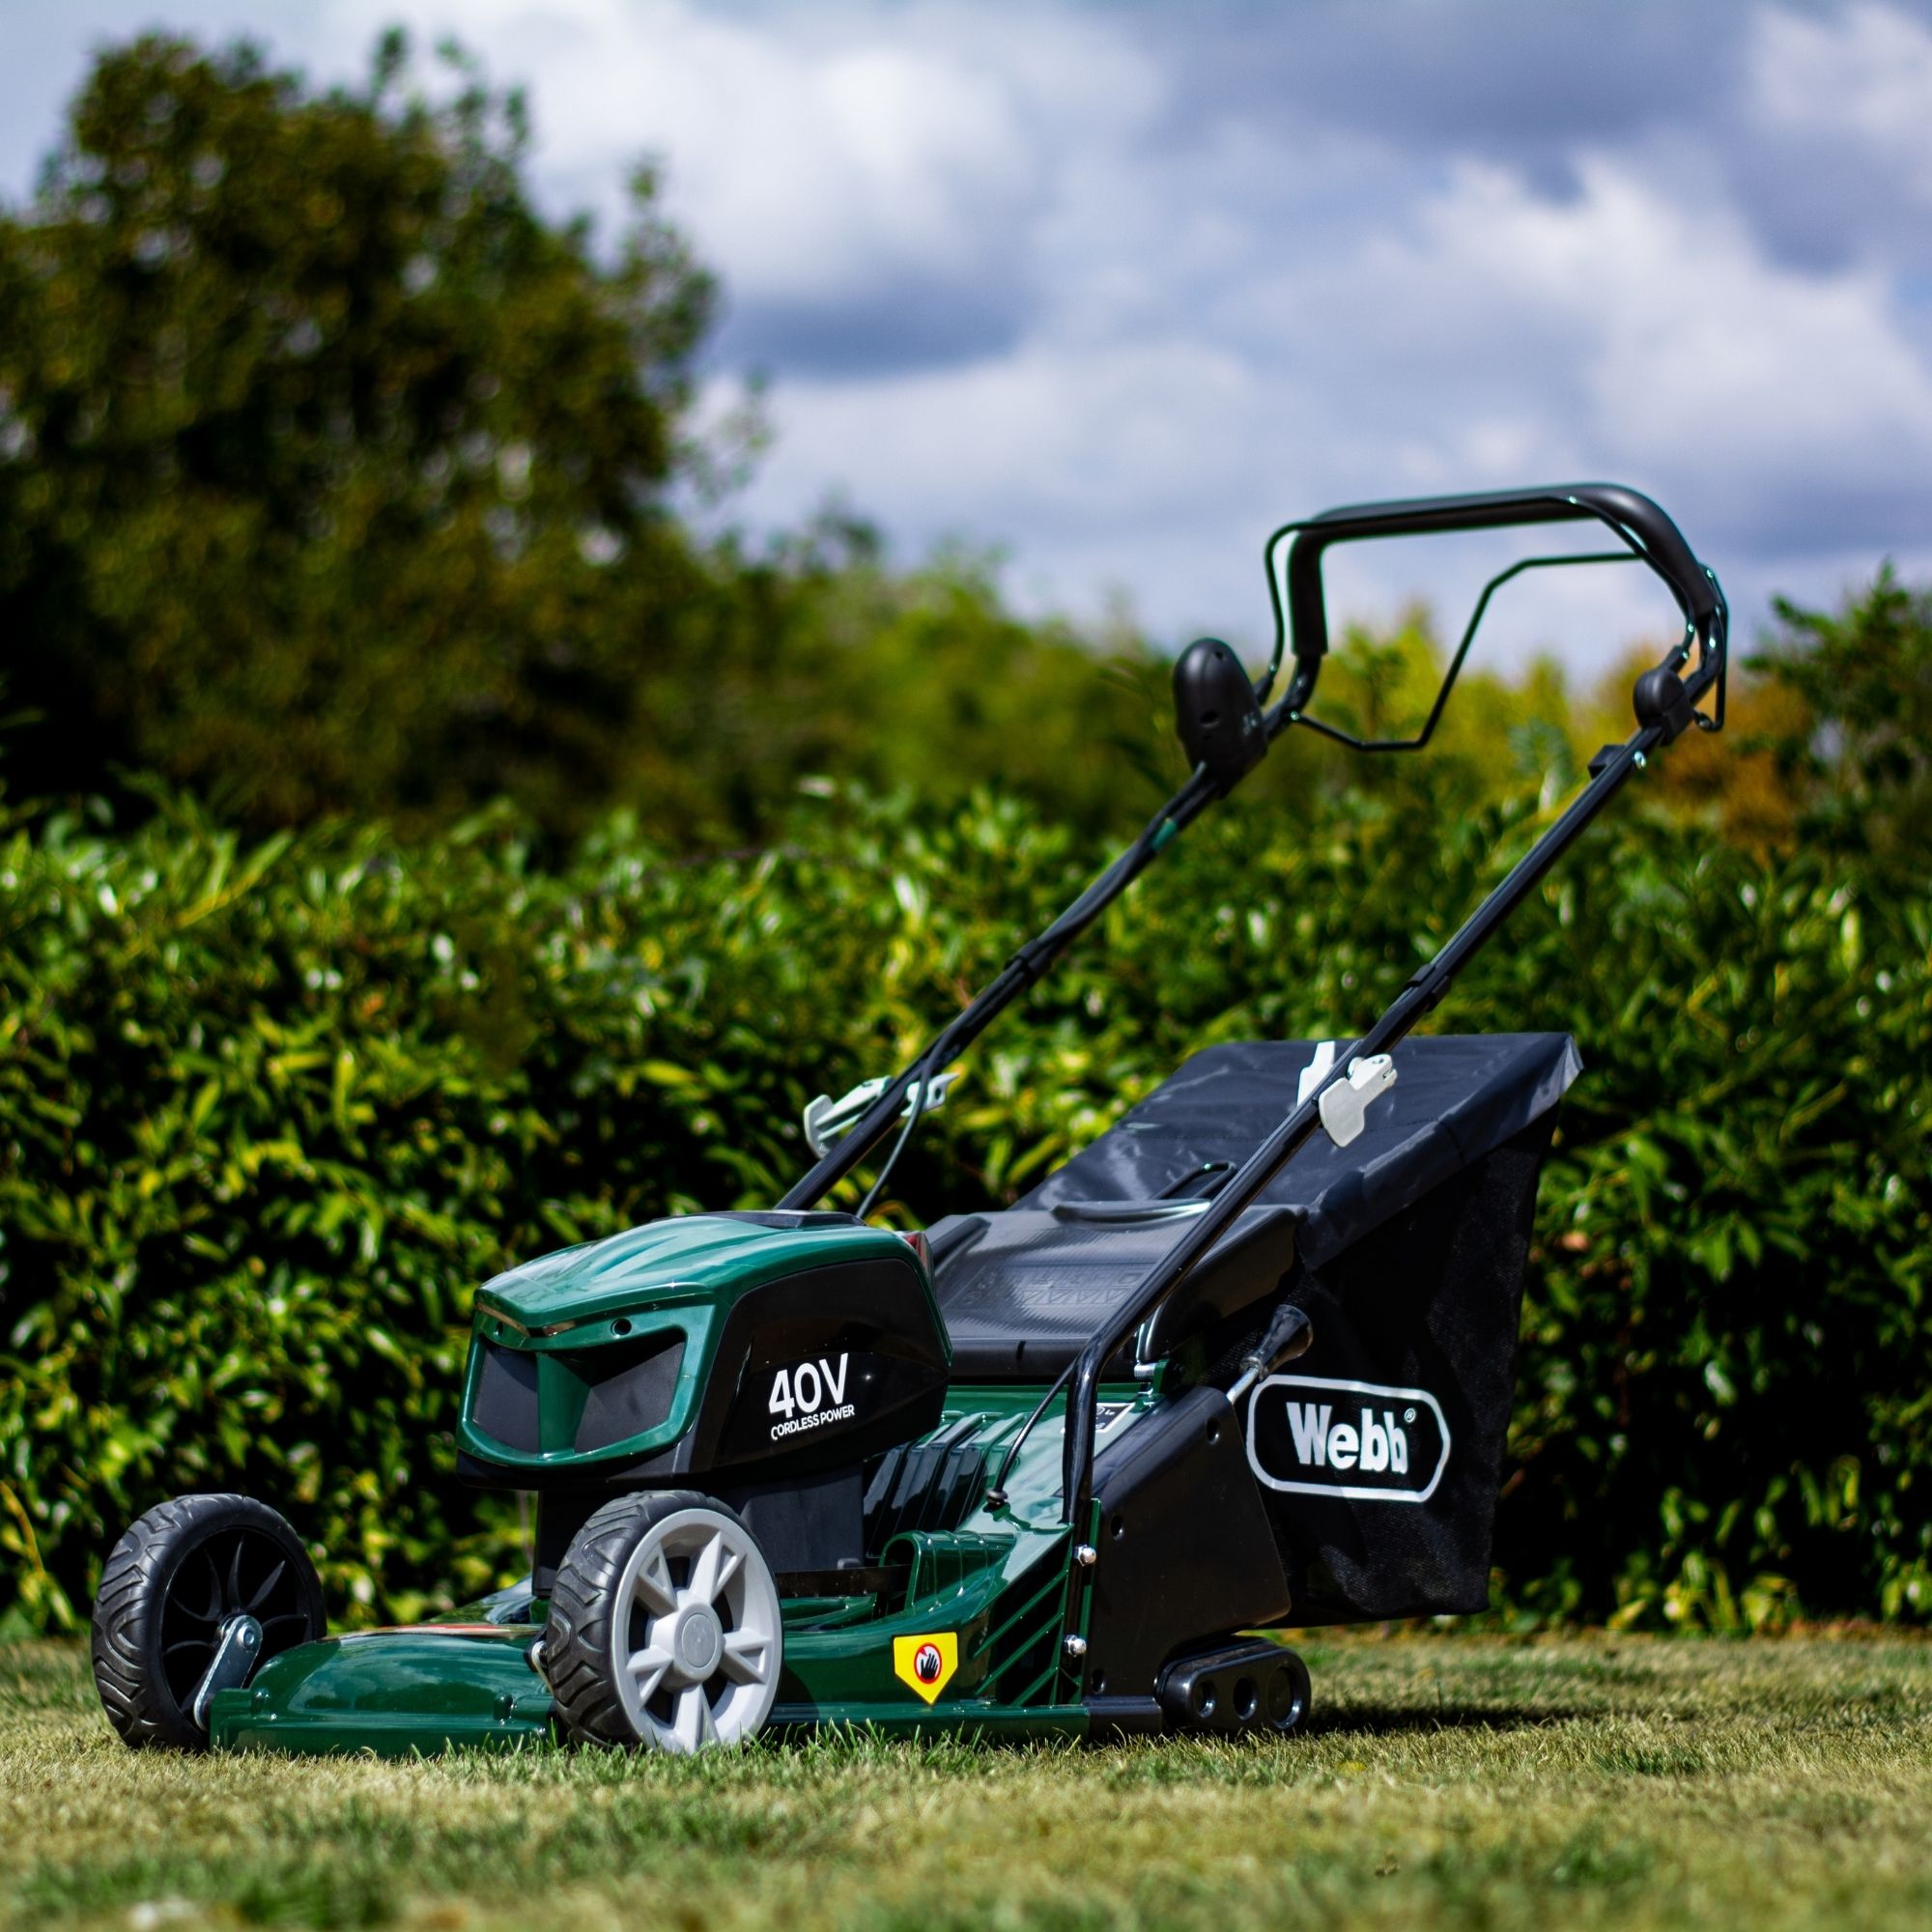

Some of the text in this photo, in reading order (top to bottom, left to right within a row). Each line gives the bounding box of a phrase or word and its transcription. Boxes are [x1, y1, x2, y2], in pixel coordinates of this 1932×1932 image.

[768, 1352, 848, 1418] 40V
[770, 1404, 855, 1440] CORDLESS POWER
